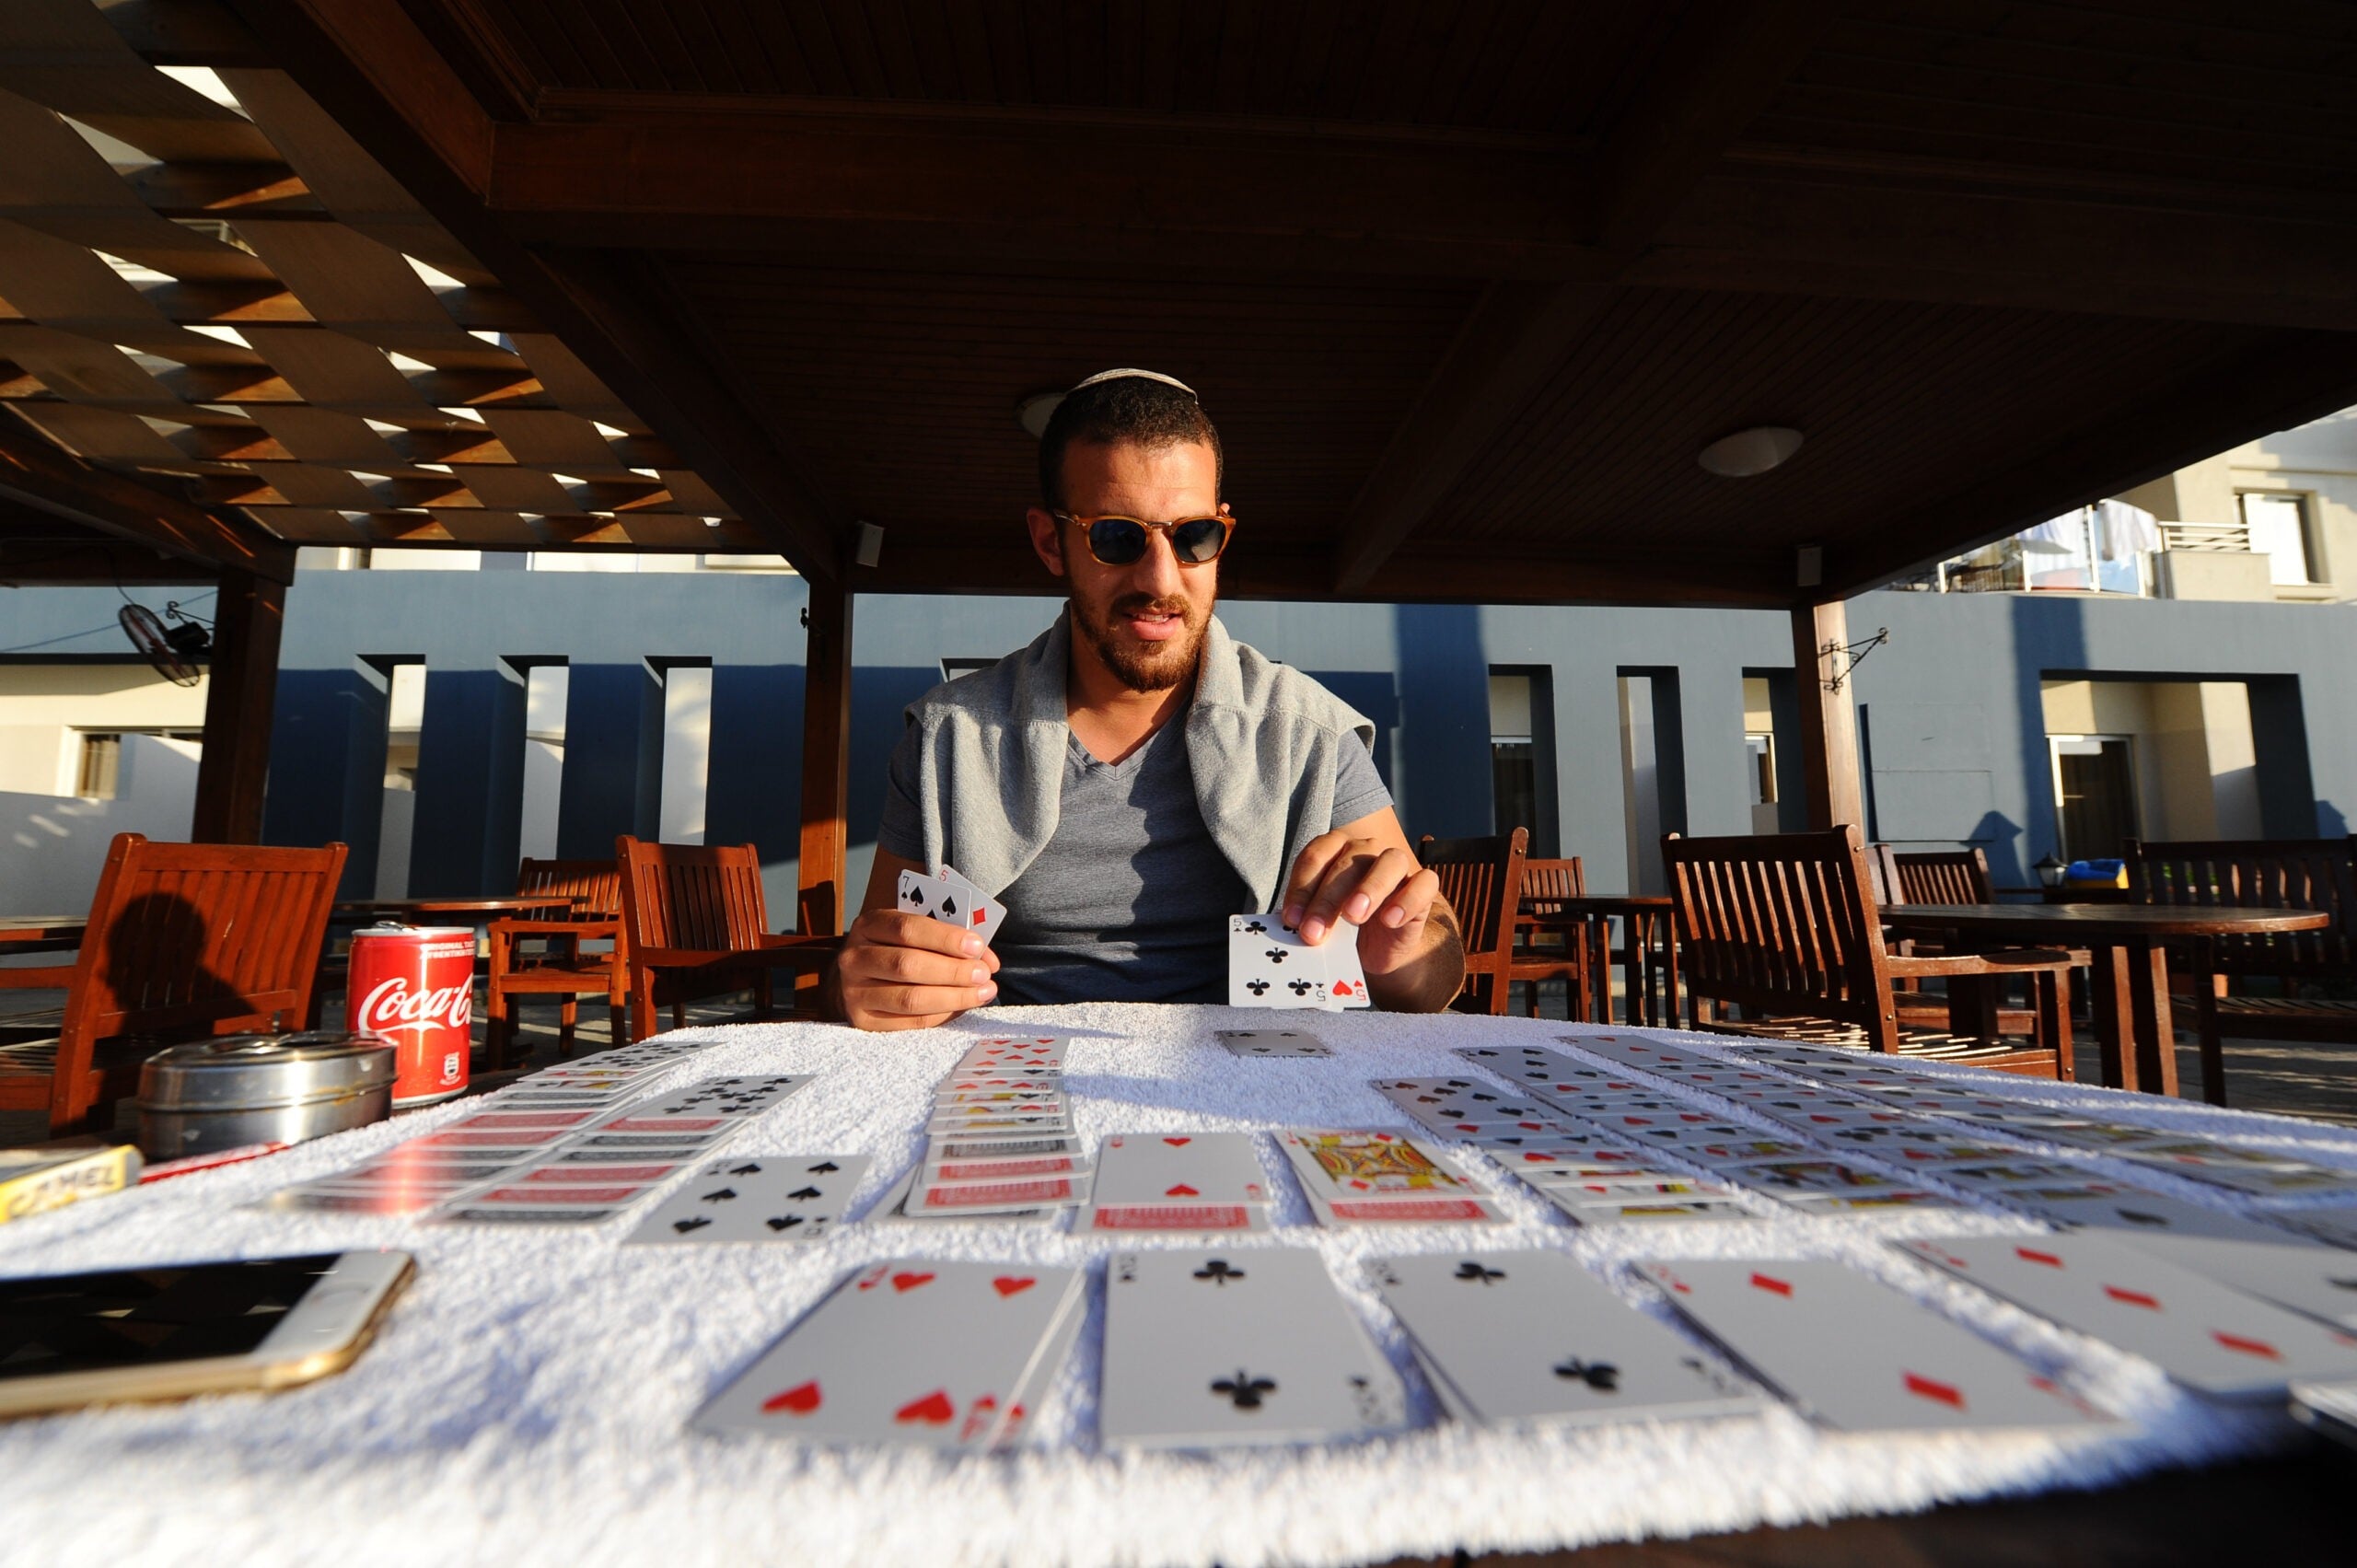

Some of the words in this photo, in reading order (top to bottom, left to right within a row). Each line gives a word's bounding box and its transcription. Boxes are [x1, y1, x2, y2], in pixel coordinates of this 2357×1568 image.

[902, 875, 910, 889] 7
[1233, 918, 1242, 927] 5
[1316, 990, 1326, 1002] 5
[1355, 989, 1366, 1001] 5
